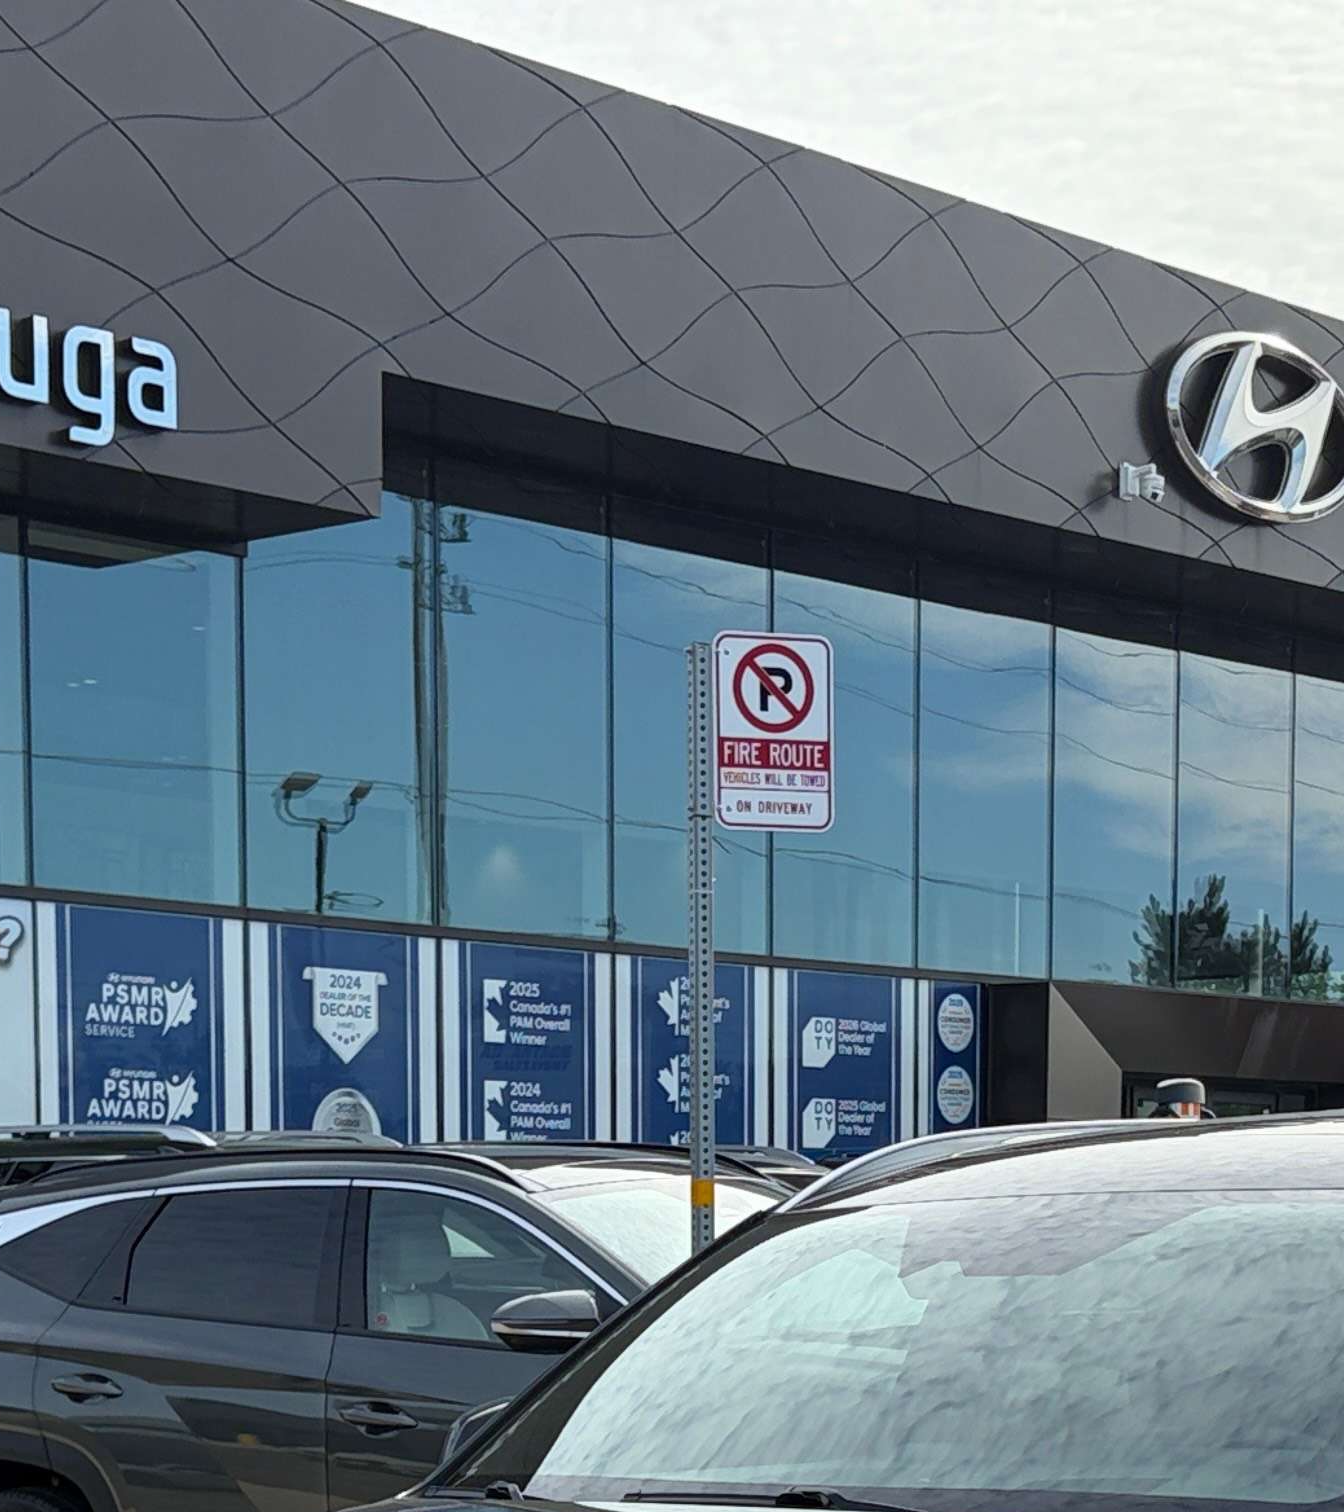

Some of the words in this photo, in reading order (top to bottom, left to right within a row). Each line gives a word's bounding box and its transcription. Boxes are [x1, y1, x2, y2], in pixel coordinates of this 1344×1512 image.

[723, 741, 762, 765] FIRE
[769, 743, 824, 768] ROUTE
[723, 771, 761, 785] VEHICLES
[765, 773, 783, 786] WILL
[786, 775, 797, 787] BE
[800, 775, 825, 788] TOWED
[737, 799, 752, 813] ON
[758, 801, 813, 815] DRIVEWAY
[329, 973, 362, 990] 2024
[509, 981, 541, 998] 2025
[102, 982, 164, 1007] PSMR
[319, 991, 346, 1001] DEALER
[347, 992, 358, 1001] OF
[358, 993, 372, 1003] THE
[85, 1002, 164, 1027] AWARD
[319, 1002, 373, 1020] DECADE
[509, 1000, 559, 1016] Canada's
[84, 1022, 136, 1038] SERVICE
[509, 1015, 534, 1029] PAM
[534, 1016, 571, 1032] Overall
[509, 1031, 547, 1047] Winner
[838, 1031, 865, 1044] Dealer
[865, 1032, 875, 1044] of
[853, 1044, 873, 1056] Year
[103, 1077, 166, 1102] PSMR
[509, 1081, 541, 1098] 2024
[86, 1097, 166, 1120] AWARD
[509, 1100, 559, 1115] Canada's
[859, 1100, 886, 1113] Global
[510, 1115, 534, 1128] PAM
[534, 1116, 571, 1130] Overall
[838, 1111, 865, 1123] Dealer
[865, 1112, 875, 1124] of
[853, 1124, 872, 1136] Year
